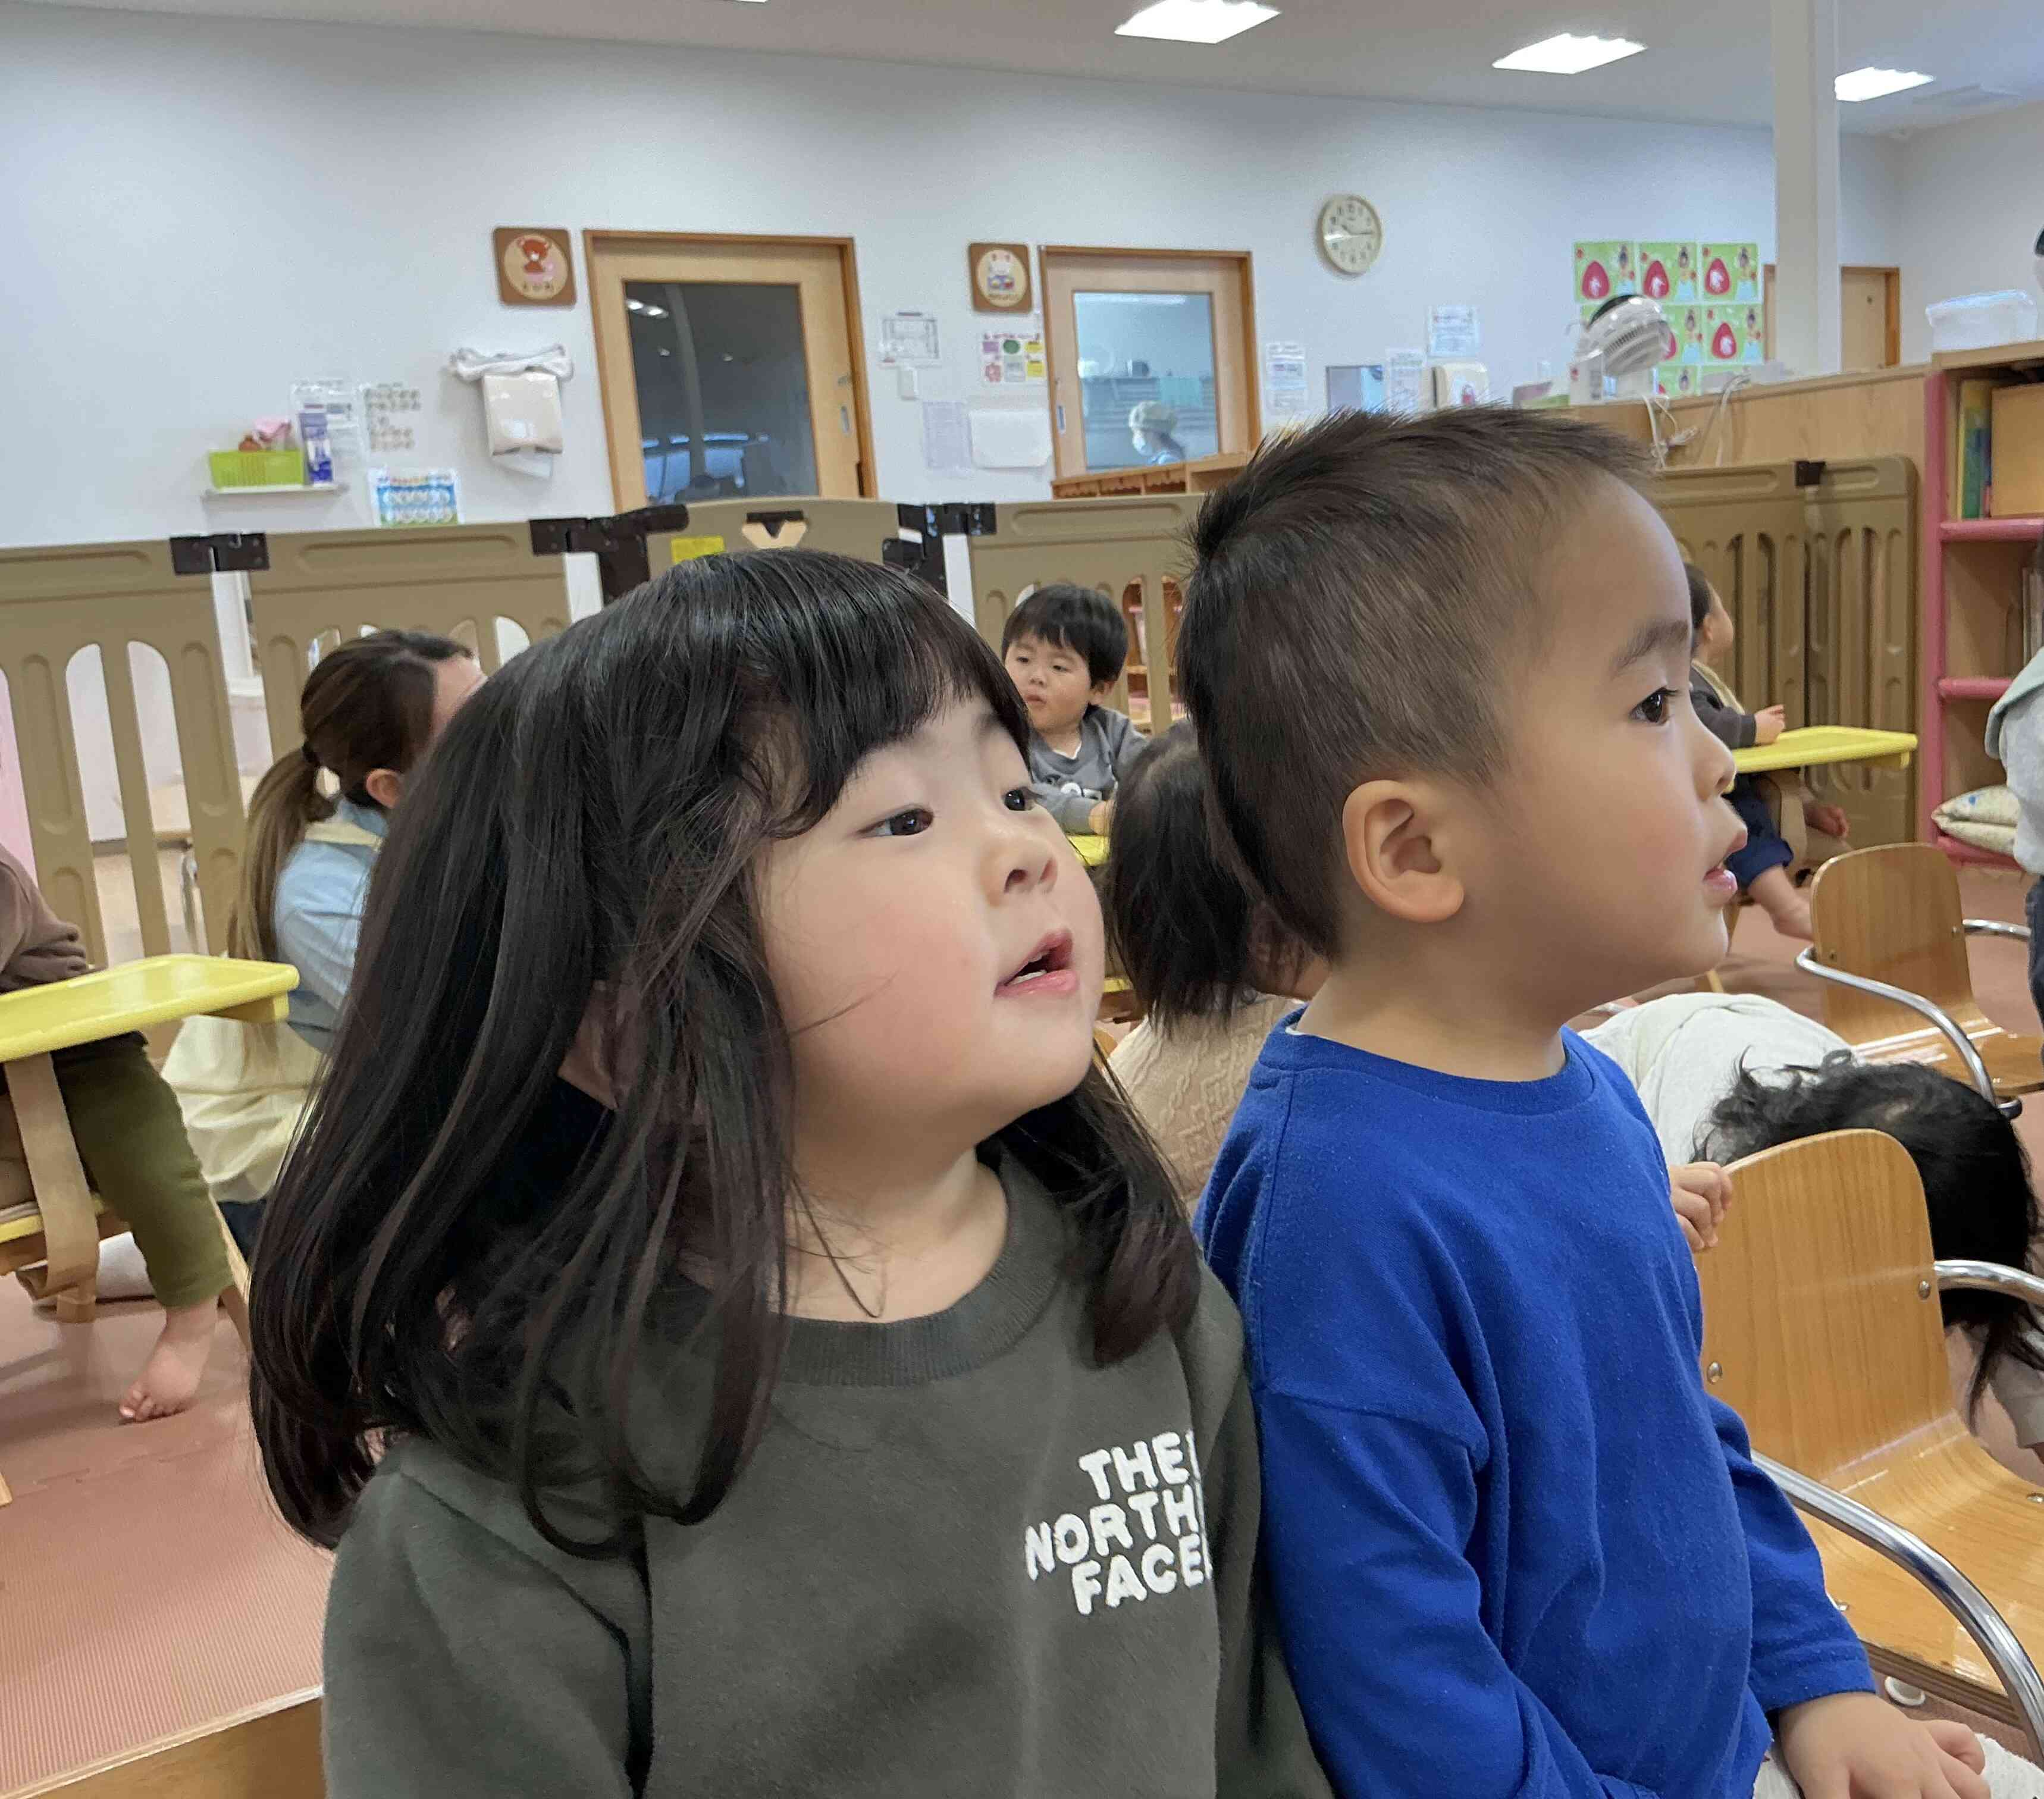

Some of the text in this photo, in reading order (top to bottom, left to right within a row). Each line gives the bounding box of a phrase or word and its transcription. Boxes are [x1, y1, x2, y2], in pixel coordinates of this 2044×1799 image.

[1079, 1431, 1189, 1500] THE
[1025, 1484, 1199, 1581] NORTH
[1072, 1533, 1204, 1615] FACE
